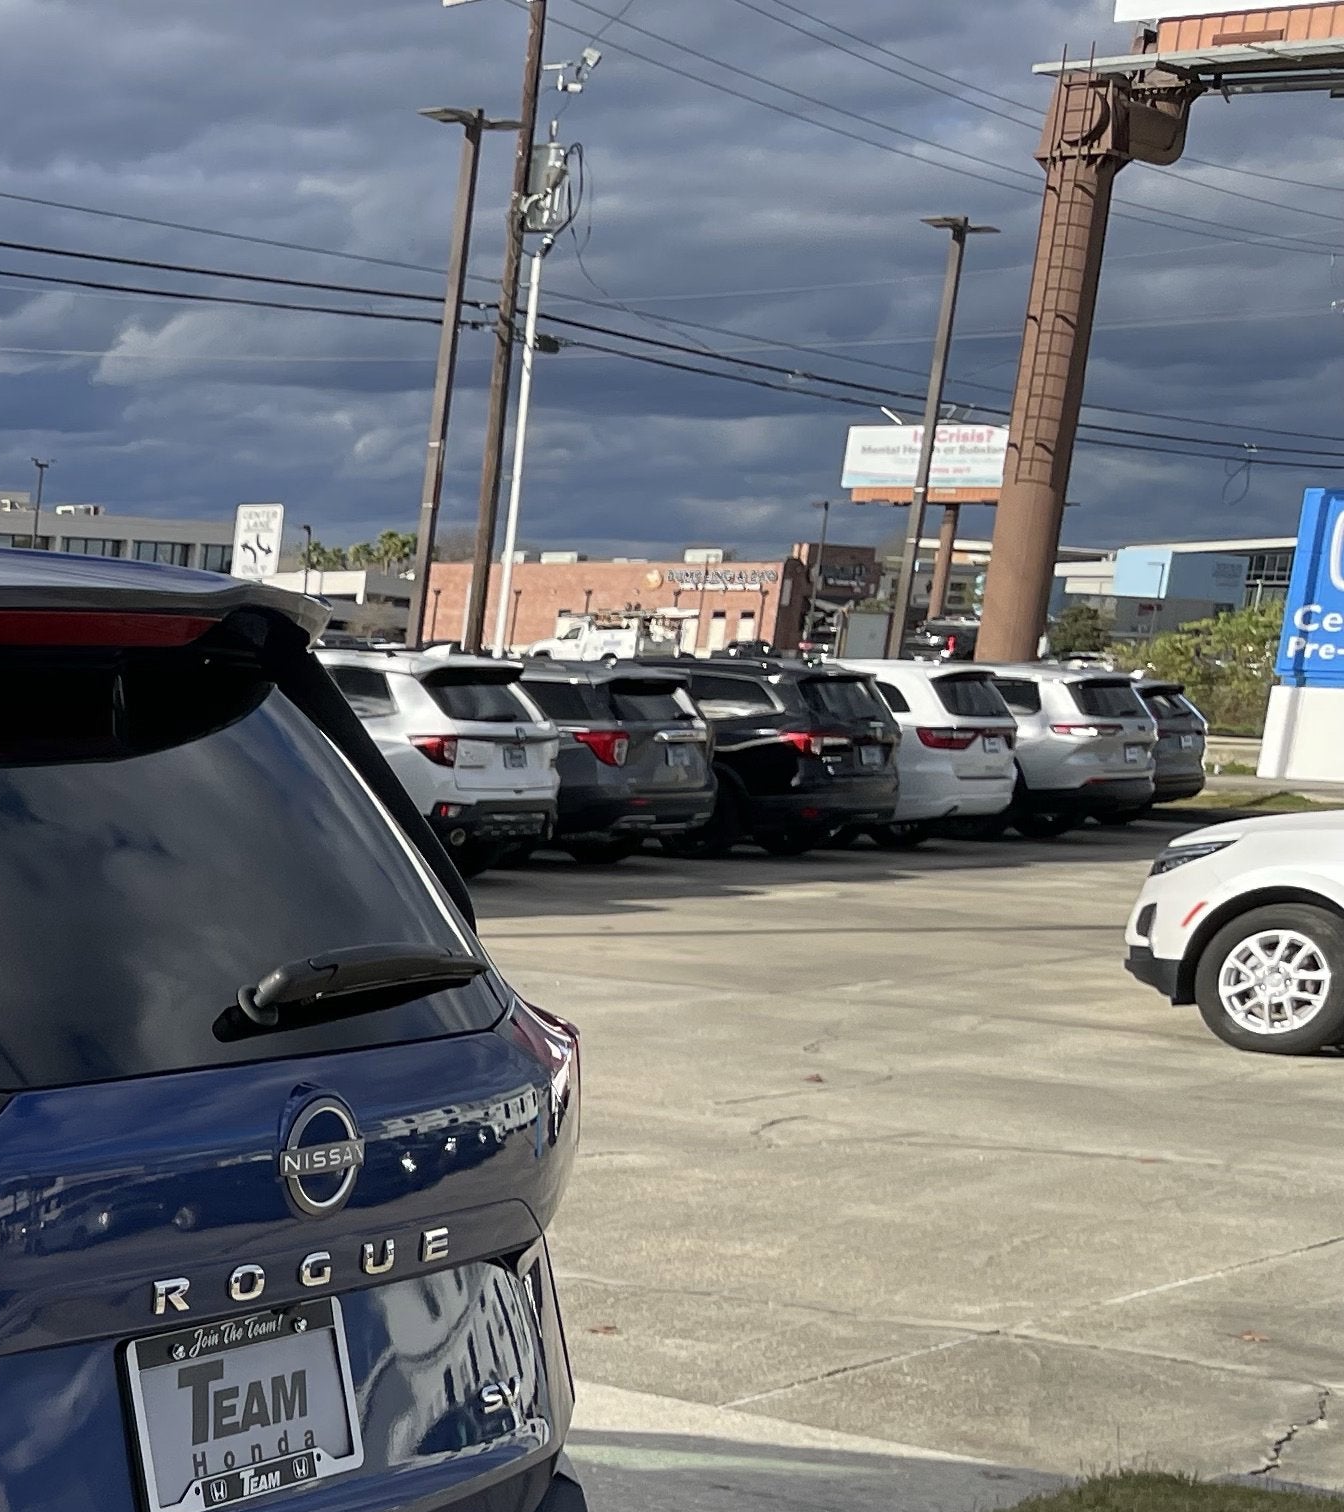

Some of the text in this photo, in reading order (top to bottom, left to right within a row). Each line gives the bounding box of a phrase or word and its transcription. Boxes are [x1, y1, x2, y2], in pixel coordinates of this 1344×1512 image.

[936, 429, 995, 444] Crisis?
[284, 1143, 365, 1173] NISSAN
[154, 1227, 449, 1315] ROGUE
[189, 1313, 284, 1358] Join The Team!
[481, 1376, 521, 1415] SV
[192, 1429, 316, 1478] Honda
